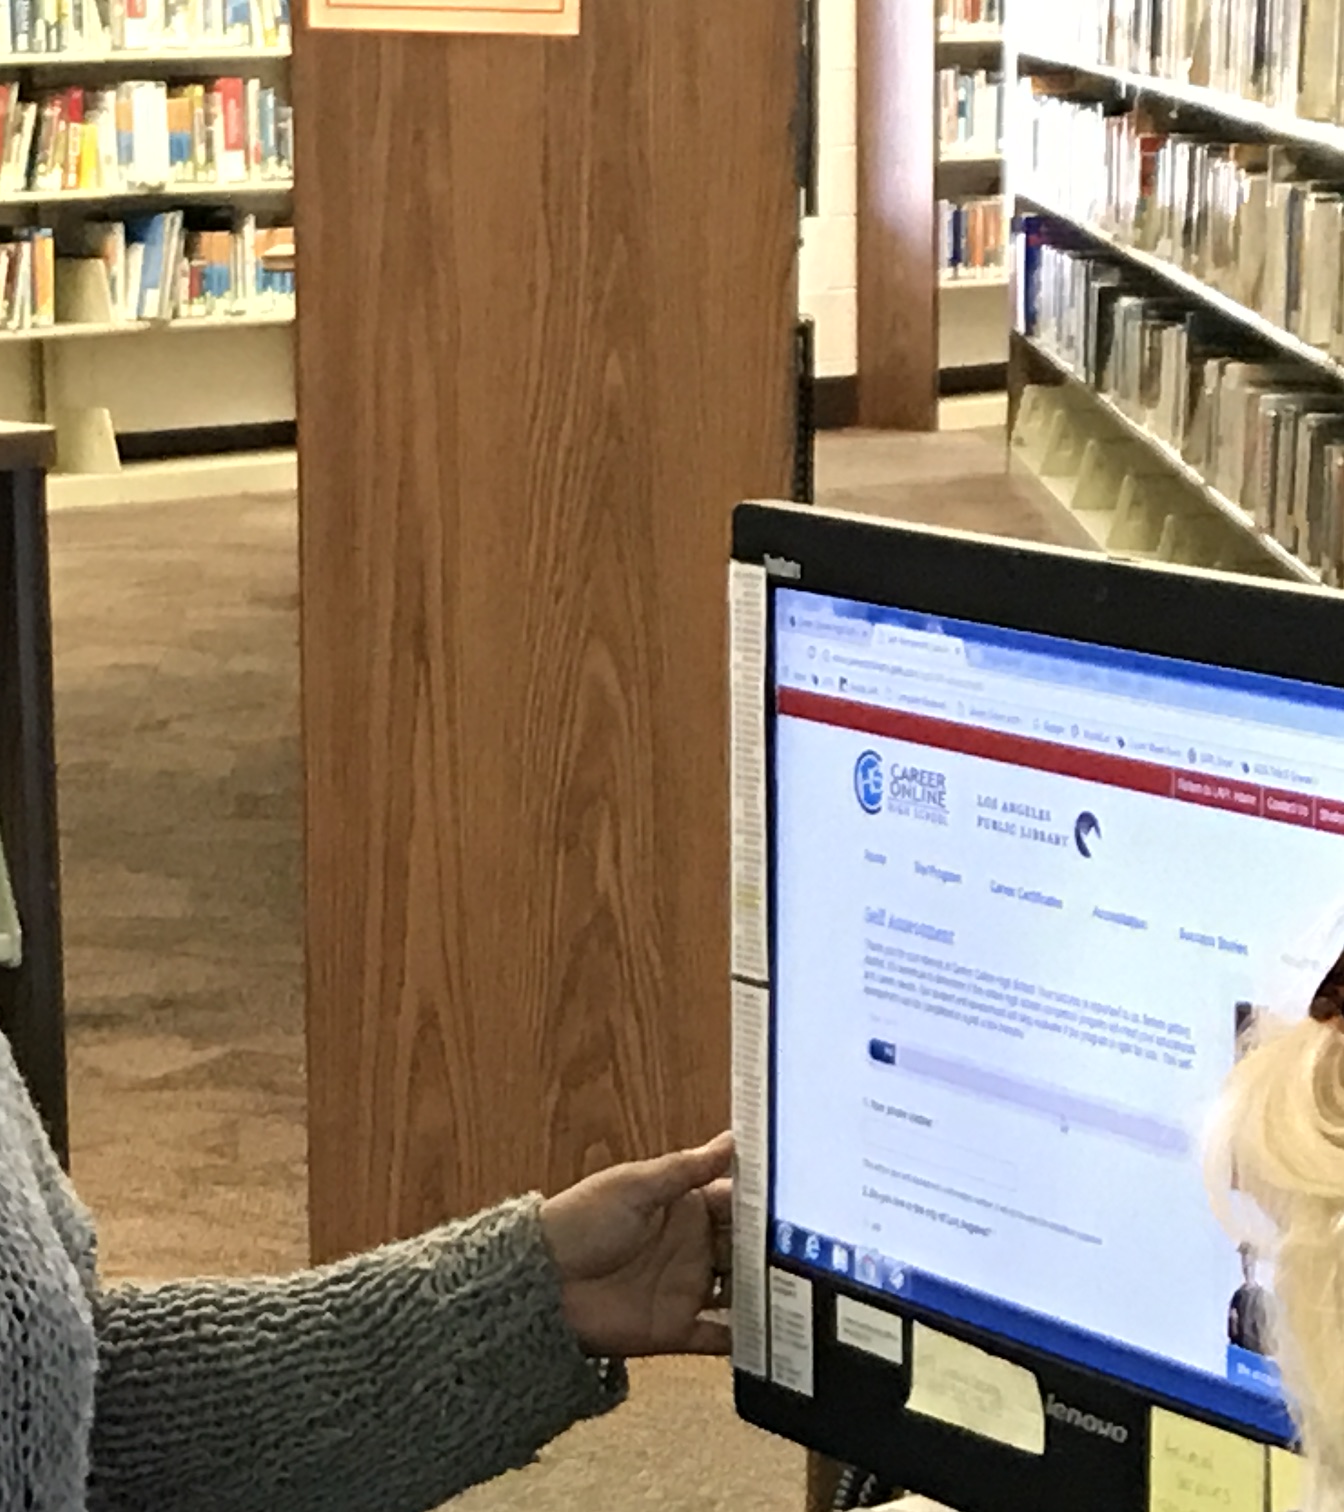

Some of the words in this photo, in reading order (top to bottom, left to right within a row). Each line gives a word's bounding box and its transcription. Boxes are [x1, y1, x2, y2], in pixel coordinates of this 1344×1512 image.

[890, 763, 948, 789] CAREER
[889, 778, 948, 808] ONLINE
[976, 794, 999, 811] LOS
[1001, 800, 1052, 822] ANGELES
[976, 816, 1018, 836] PUBLIC
[1019, 825, 1071, 847] LIBRARY
[1045, 1392, 1129, 1444] lenovo
